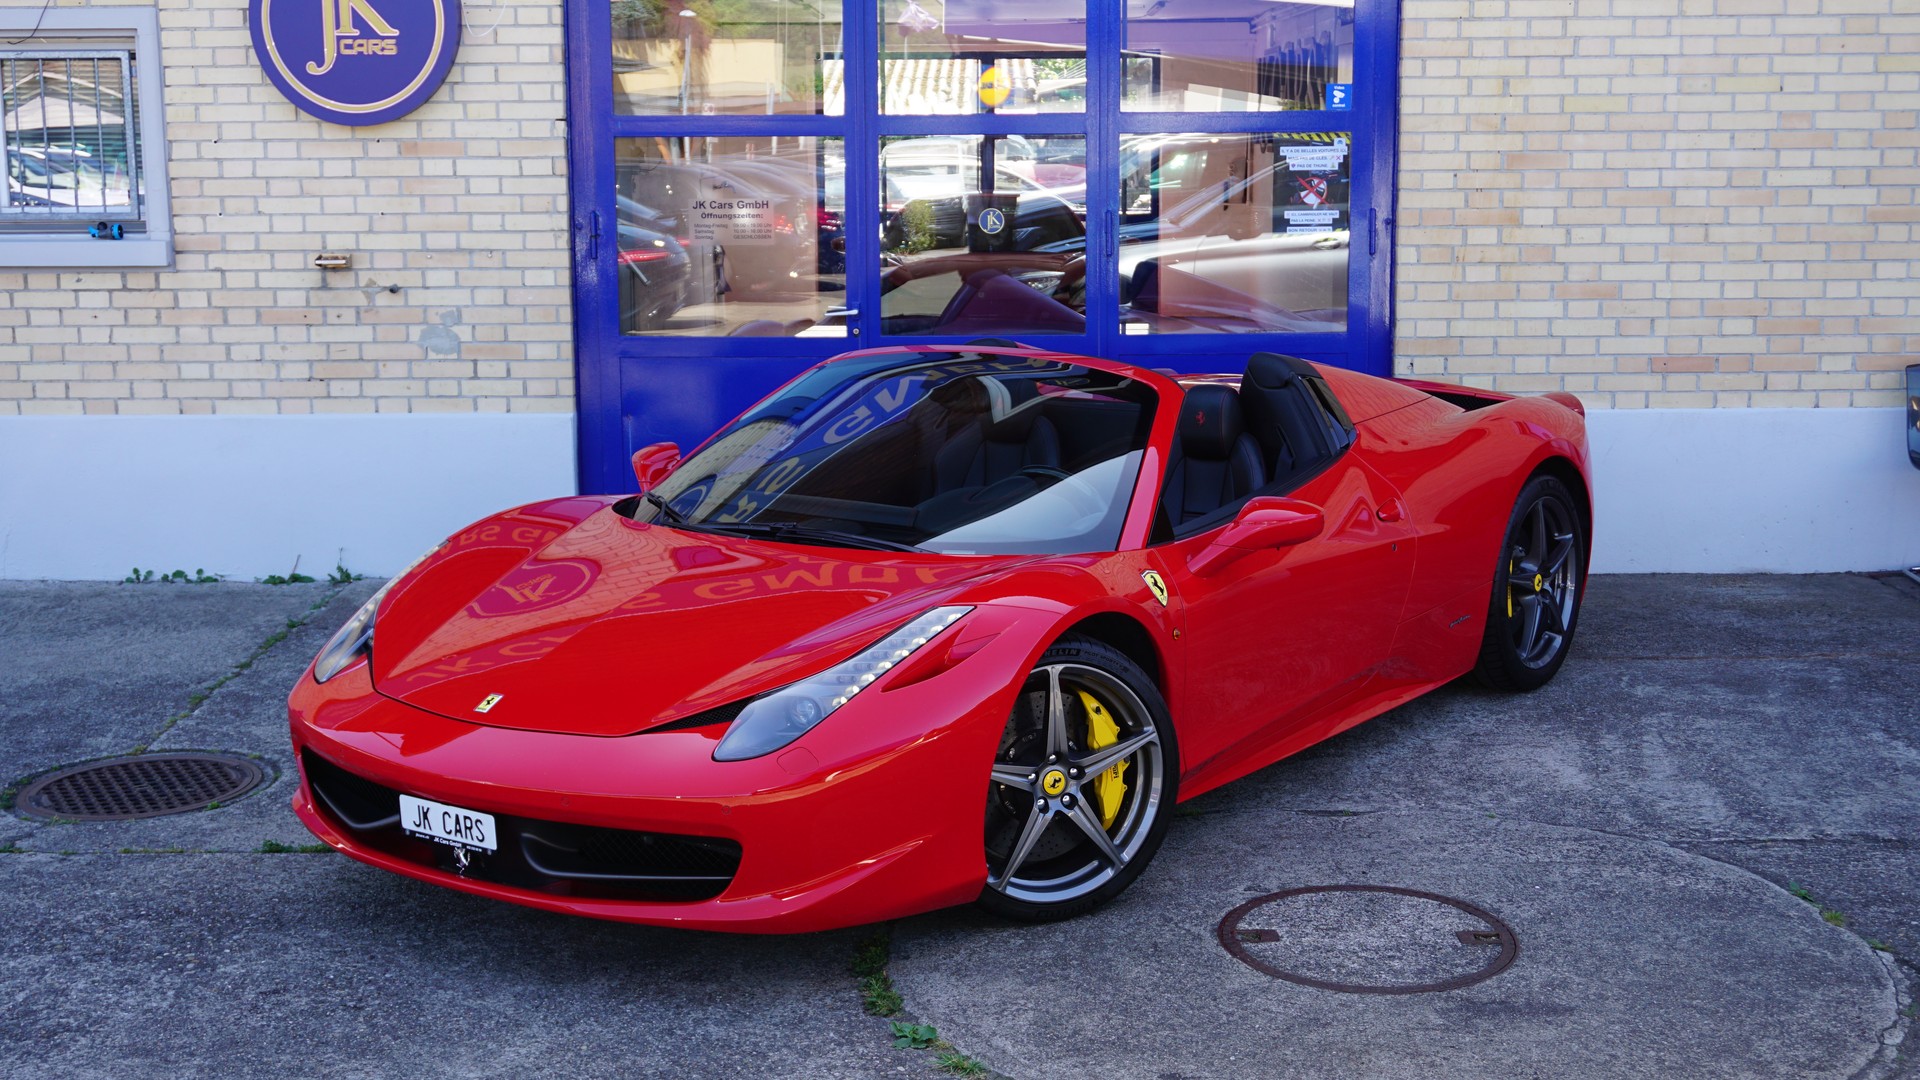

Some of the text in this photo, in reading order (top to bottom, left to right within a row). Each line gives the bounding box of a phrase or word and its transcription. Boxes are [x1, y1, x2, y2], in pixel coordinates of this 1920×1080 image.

[340, 38, 398, 56] CARS
[692, 200, 769, 209] JK Cars GmbH
[701, 212, 763, 220] Öffnungszeiten:
[413, 805, 485, 842] JK CARS
